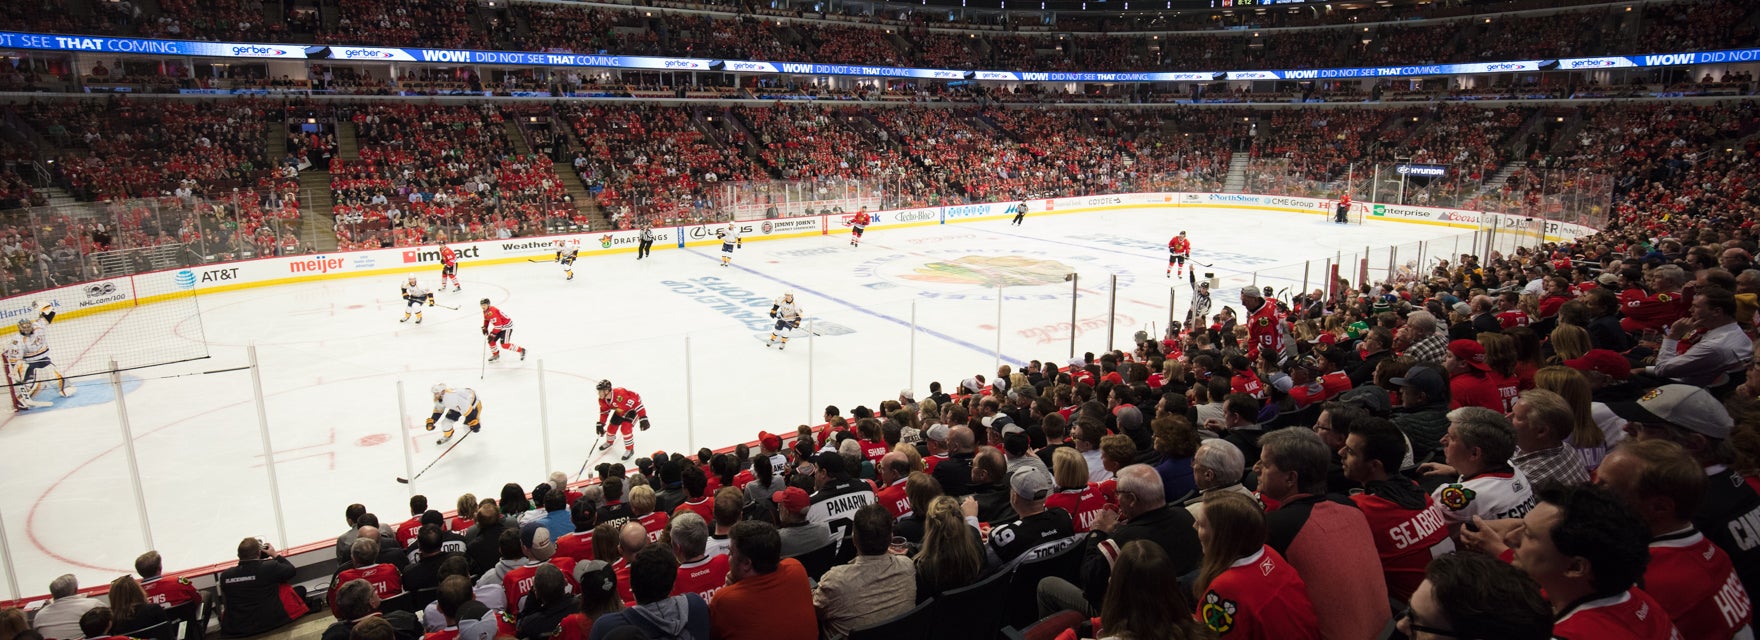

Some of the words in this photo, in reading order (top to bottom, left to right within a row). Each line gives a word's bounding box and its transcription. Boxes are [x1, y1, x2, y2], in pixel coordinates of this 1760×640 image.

[21, 36, 52, 49] SEE
[56, 37, 103, 51] THAT
[107, 39, 181, 54] COMING.
[232, 45, 273, 57] gerber
[345, 48, 380, 59] gerber
[423, 50, 471, 63] WOW!
[476, 52, 497, 63] DID
[500, 53, 524, 64] NOT
[527, 55, 545, 65] SEE
[547, 55, 576, 66] THAT
[1645, 53, 1696, 66] WOW!
[1701, 52, 1726, 63] DID
[1729, 50, 1760, 61] NOT
[664, 59, 690, 68] gerber
[733, 60, 757, 69] gerber
[782, 63, 813, 73] WOW!
[816, 65, 830, 73] DID
[831, 65, 848, 74] NOT
[849, 66, 861, 74] SEE
[862, 66, 880, 75] THAT
[1486, 63, 1516, 72] gerber
[1571, 58, 1604, 68] gerber
[1022, 72, 1049, 81] WOW!
[1051, 72, 1065, 80] DID
[1284, 70, 1318, 79] WOW!
[1321, 70, 1337, 78] DID
[1339, 69, 1358, 77] NOT
[1361, 68, 1375, 76] SEE
[1411, 167, 1445, 176] HYUNDAI
[1212, 193, 1260, 203] NorthShore
[1271, 197, 1289, 206] CME
[1291, 199, 1314, 209] Group
[1376, 206, 1431, 218] enterprise
[1448, 211, 1476, 223] Coors
[774, 220, 795, 229] JIMMY
[795, 219, 816, 227] JOHN'S
[502, 238, 580, 251] WeatherTh
[613, 234, 669, 245] DRAFTNGS
[417, 246, 480, 263] imact
[290, 255, 345, 274] meijer
[202, 268, 240, 283] AT&T
[79, 293, 126, 307] NHL.com/100
[0, 305, 33, 319] Harris
[1259, 334, 1273, 346] 19
[773, 463, 785, 472] ANE
[826, 494, 868, 517] PANARIN
[1389, 505, 1446, 550] SEABRO
